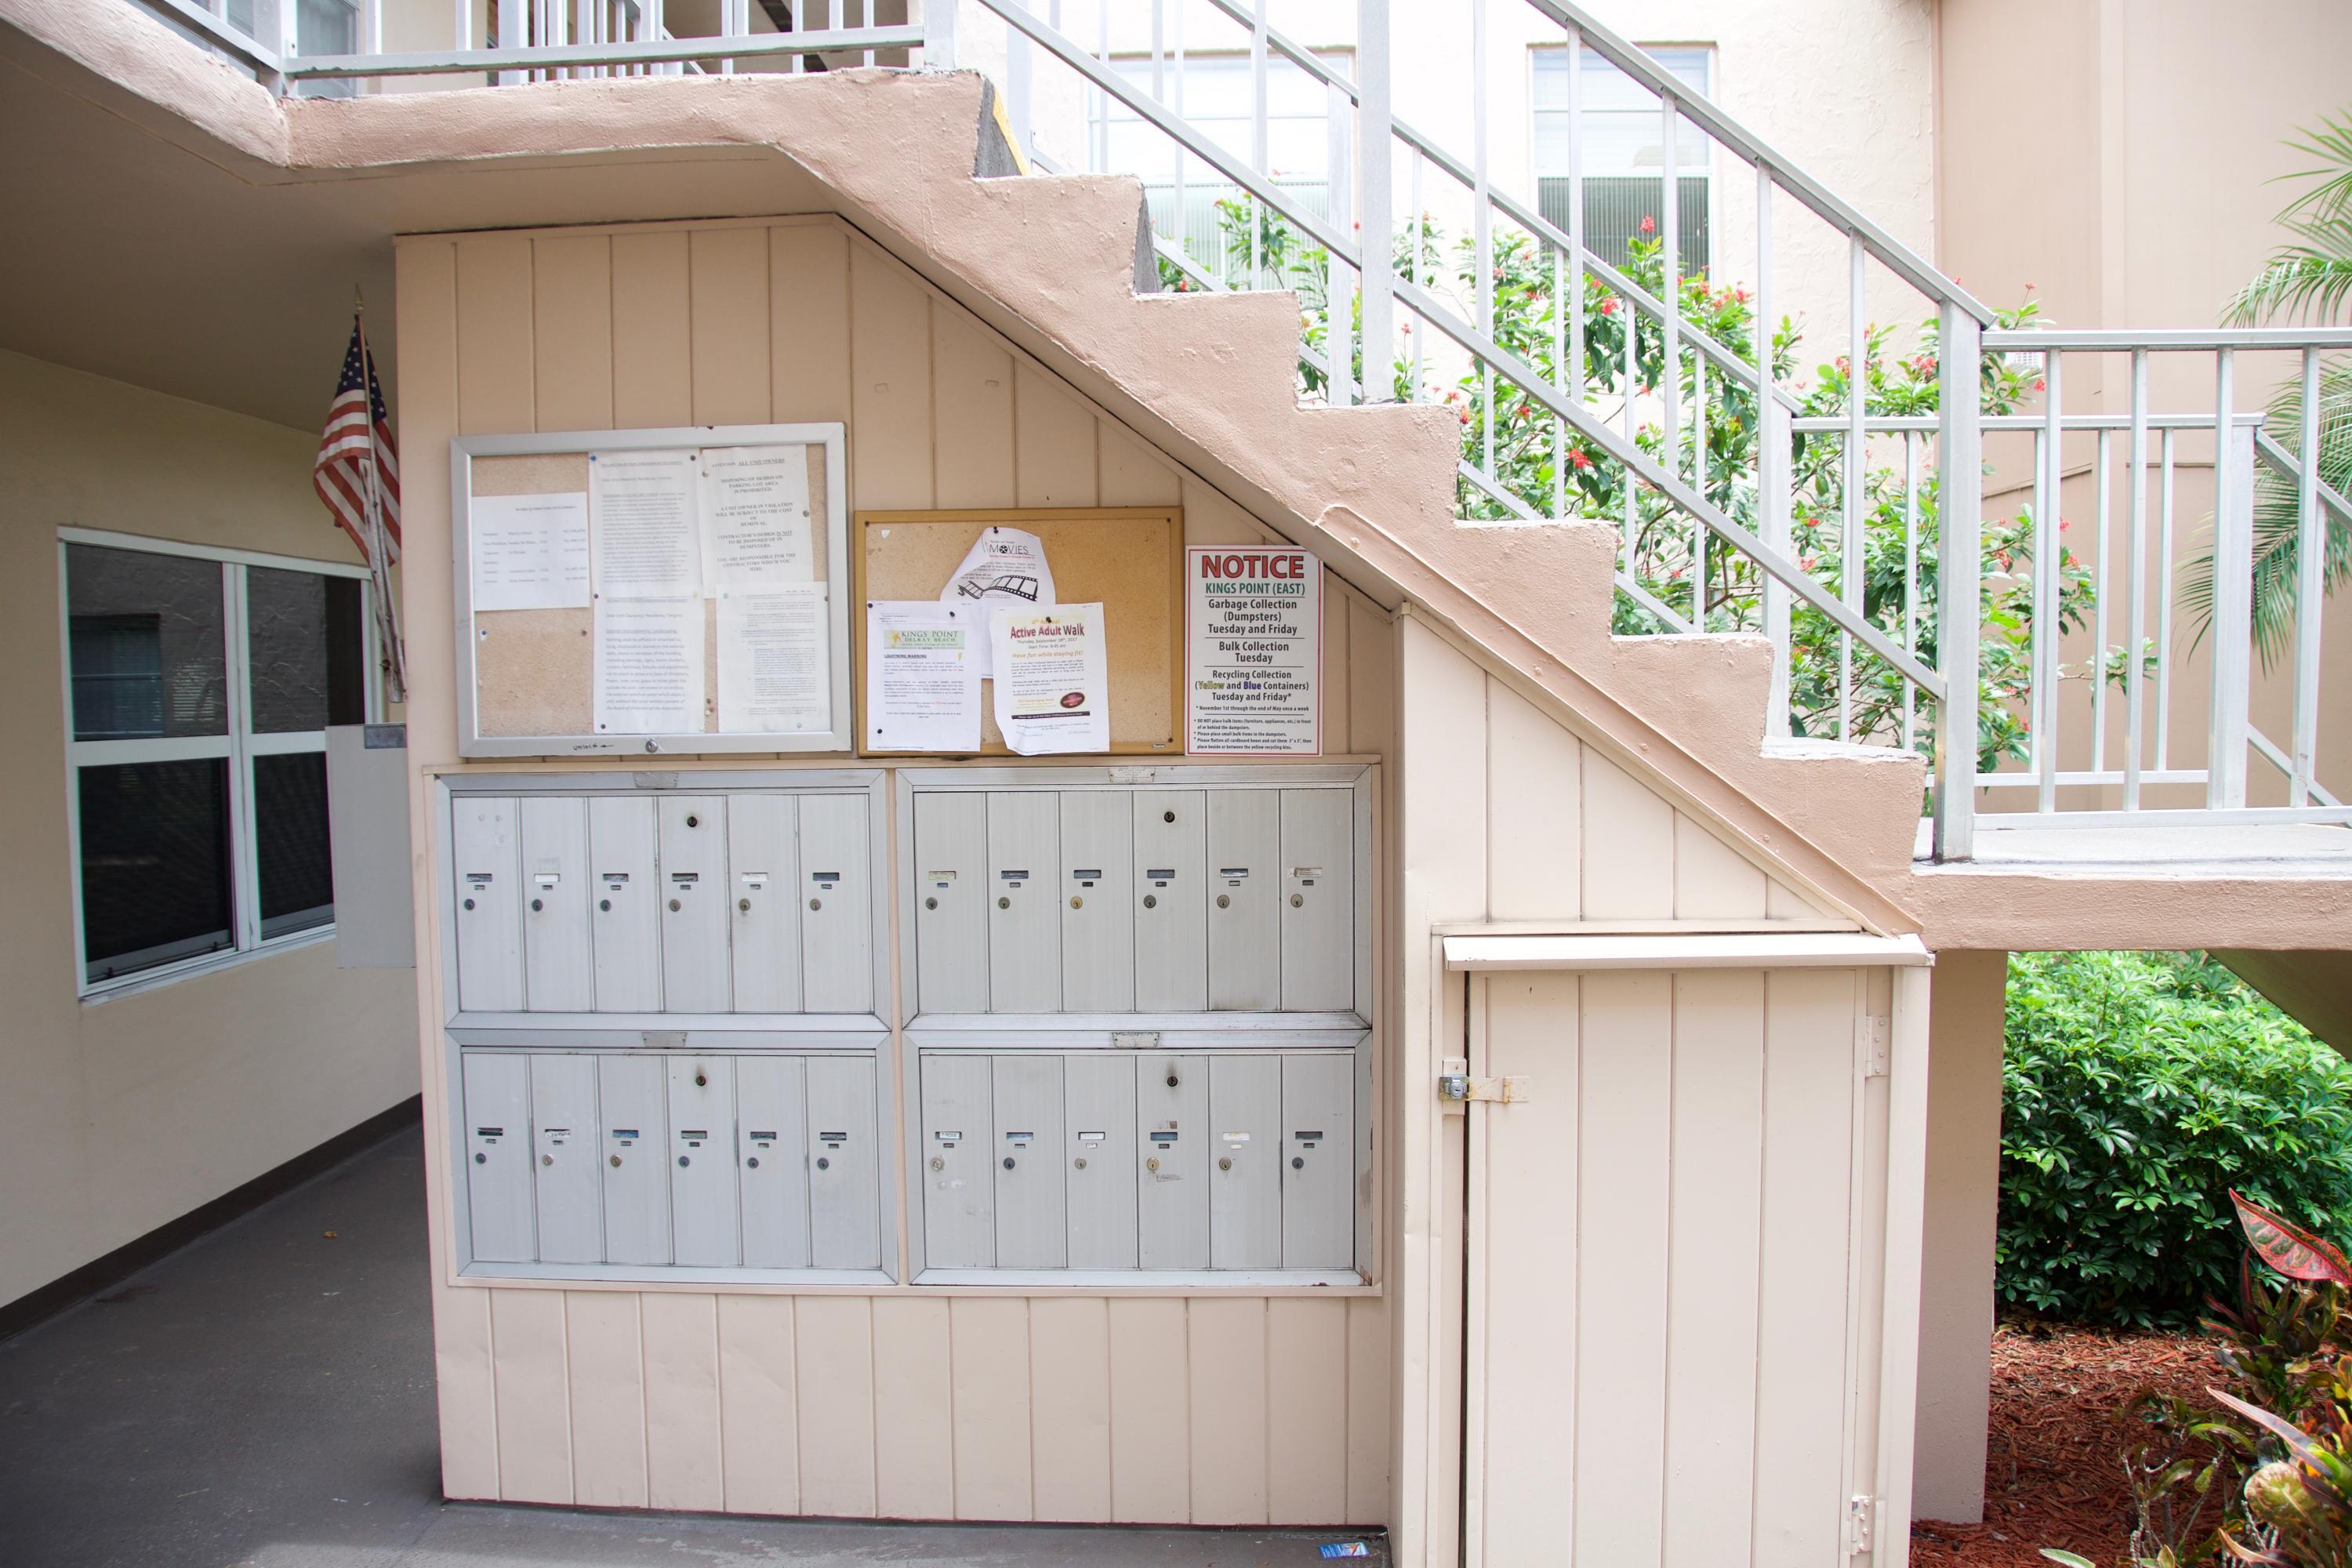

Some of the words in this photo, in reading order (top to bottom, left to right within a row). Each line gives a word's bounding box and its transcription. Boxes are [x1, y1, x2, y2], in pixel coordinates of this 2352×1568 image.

[1202, 555, 1305, 579] NOTICE
[1206, 583, 1236, 594] KINGS
[1240, 583, 1270, 594] POINT
[1273, 583, 1305, 596] (EAST)
[1209, 599, 1247, 611] Garbage
[1250, 599, 1297, 609] Collection
[1224, 612, 1282, 622] (Dumpsters)
[1011, 626, 1036, 639] Active
[1039, 625, 1062, 636] Adult
[1063, 622, 1085, 637] Walk
[1208, 624, 1245, 635] Tuesday
[1248, 624, 1265, 633] and
[1269, 624, 1298, 636] Friday
[1219, 641, 1240, 652] Bulk
[1243, 642, 1289, 652] Collection
[1236, 653, 1272, 664] Tuesday
[1213, 670, 1250, 680] Recycling
[1252, 670, 1291, 679] Collection
[1195, 681, 1225, 690] (Yellow
[1226, 681, 1241, 690] and
[1243, 681, 1261, 690] Blue
[1263, 681, 1309, 691] Containers)
[1212, 692, 1244, 702] Tuesday
[1246, 692, 1261, 701] and
